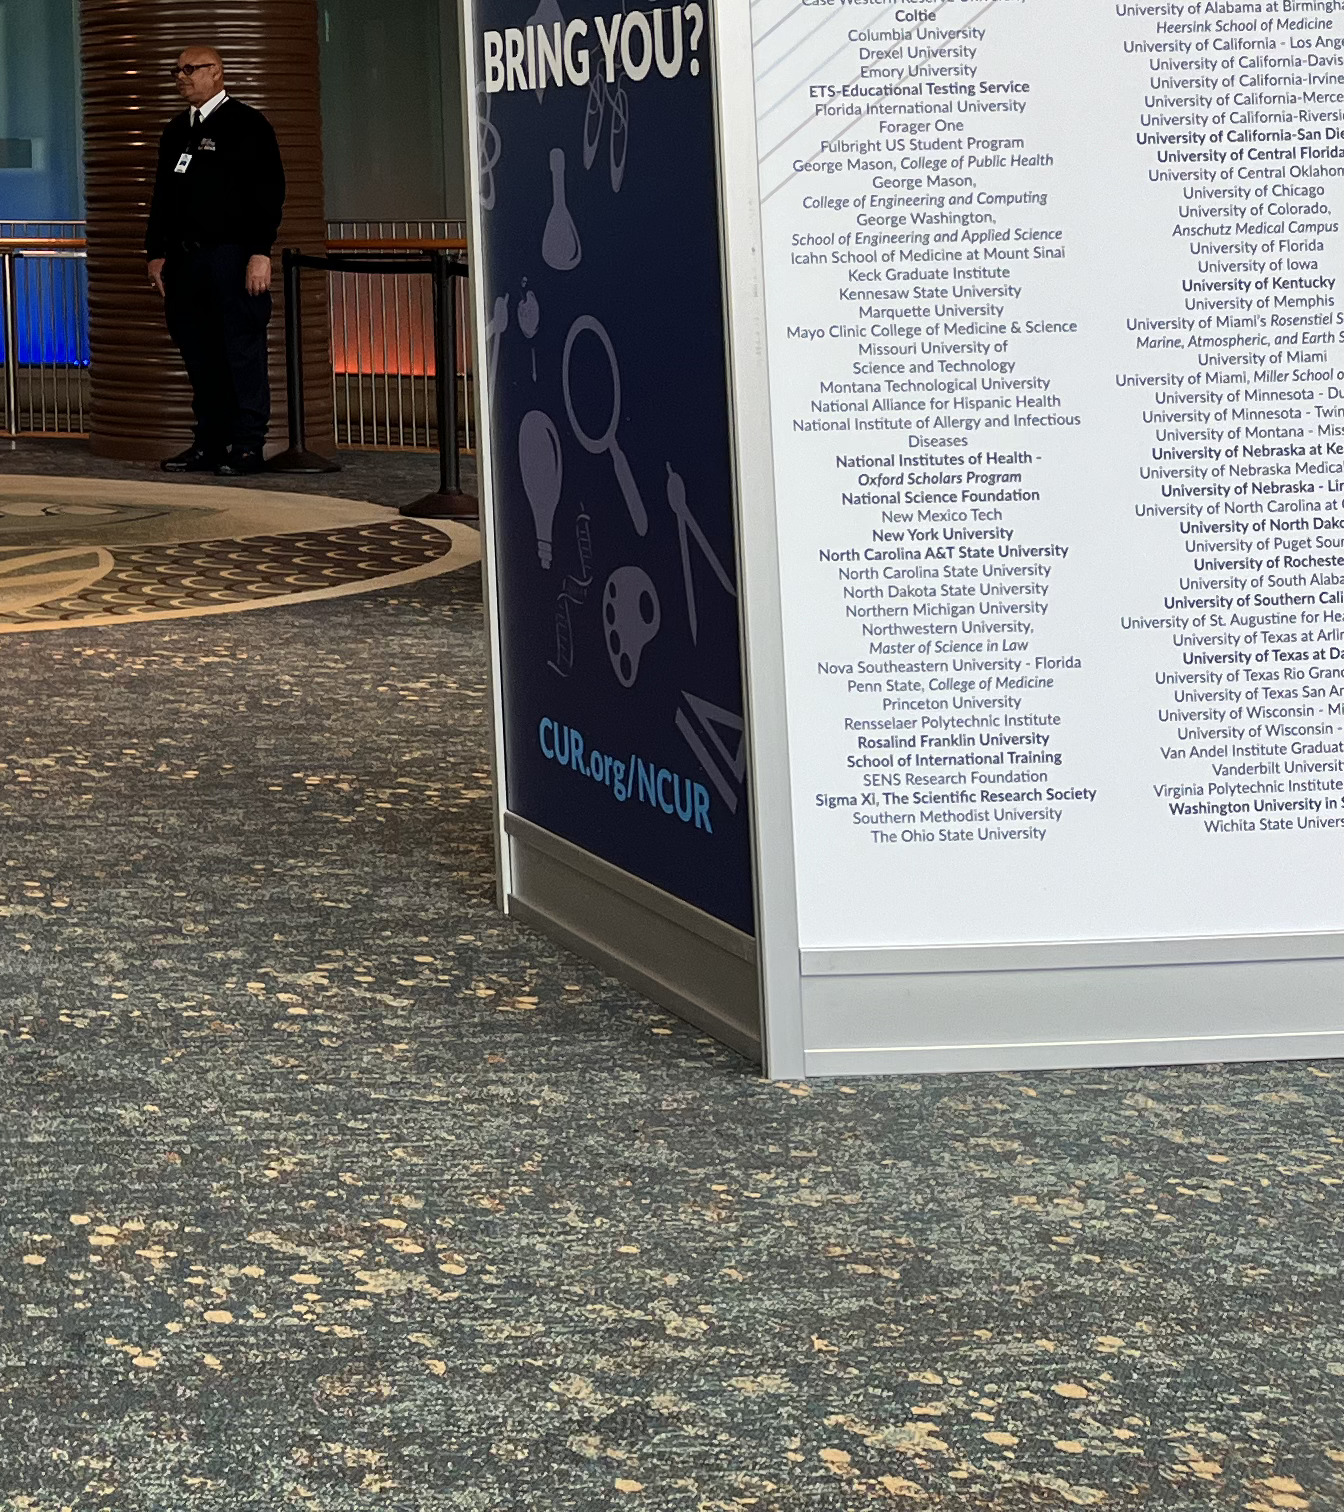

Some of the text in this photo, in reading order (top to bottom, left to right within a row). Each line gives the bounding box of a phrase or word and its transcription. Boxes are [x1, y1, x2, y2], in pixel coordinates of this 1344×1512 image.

[895, 9, 936, 23] Coltie
[483, 3, 703, 94] BRING YOU?
[859, 45, 977, 61] Drexel University
[809, 81, 1030, 99] ETS-Educational Testing Service
[821, 137, 1024, 154] Fulbright US Student Program
[848, 266, 1011, 281] Keck Graduate Institute
[1182, 275, 1335, 292] University of Kentucky
[820, 377, 1051, 395] Montana Technological University
[841, 488, 1040, 506] National Science Foundation
[872, 527, 1014, 542] New York University
[883, 695, 1022, 711] Princeton University
[847, 751, 1062, 769] School of International Training
[1161, 743, 1287, 760] Van Andel Institute
[538, 716, 712, 834] CUR.org/NCUR
